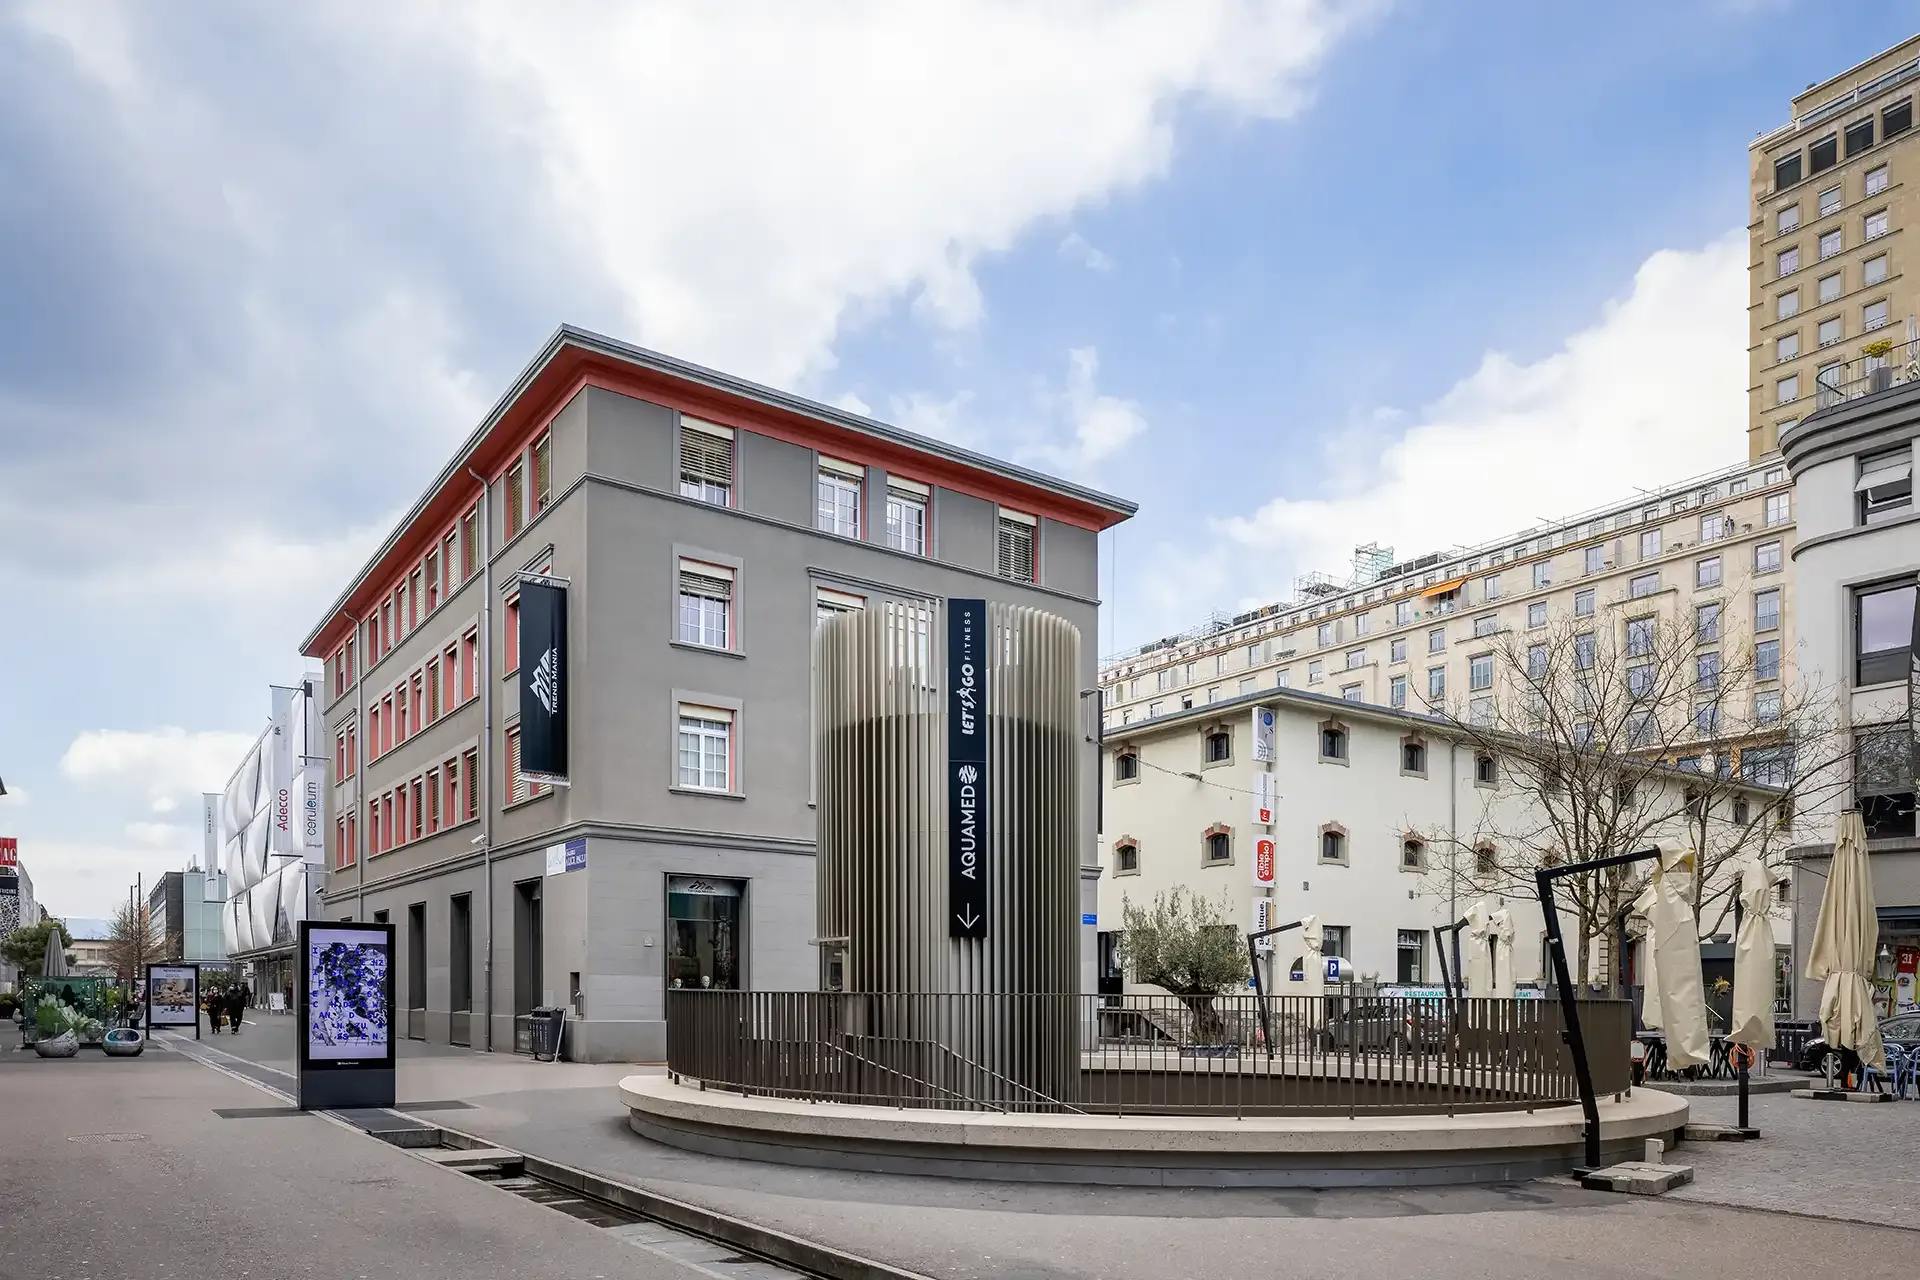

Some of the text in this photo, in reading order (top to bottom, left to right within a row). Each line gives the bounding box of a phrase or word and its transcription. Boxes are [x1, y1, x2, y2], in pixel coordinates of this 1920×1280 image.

[961, 611, 976, 735] LET'S GO FITNESS
[276, 789, 288, 832] Adecco
[304, 781, 317, 836] ceruleum
[961, 785, 977, 879] AQUAMED
[0, 848, 16, 862] AG
[1330, 963, 1336, 975] P
[1902, 954, 1912, 964] 31
